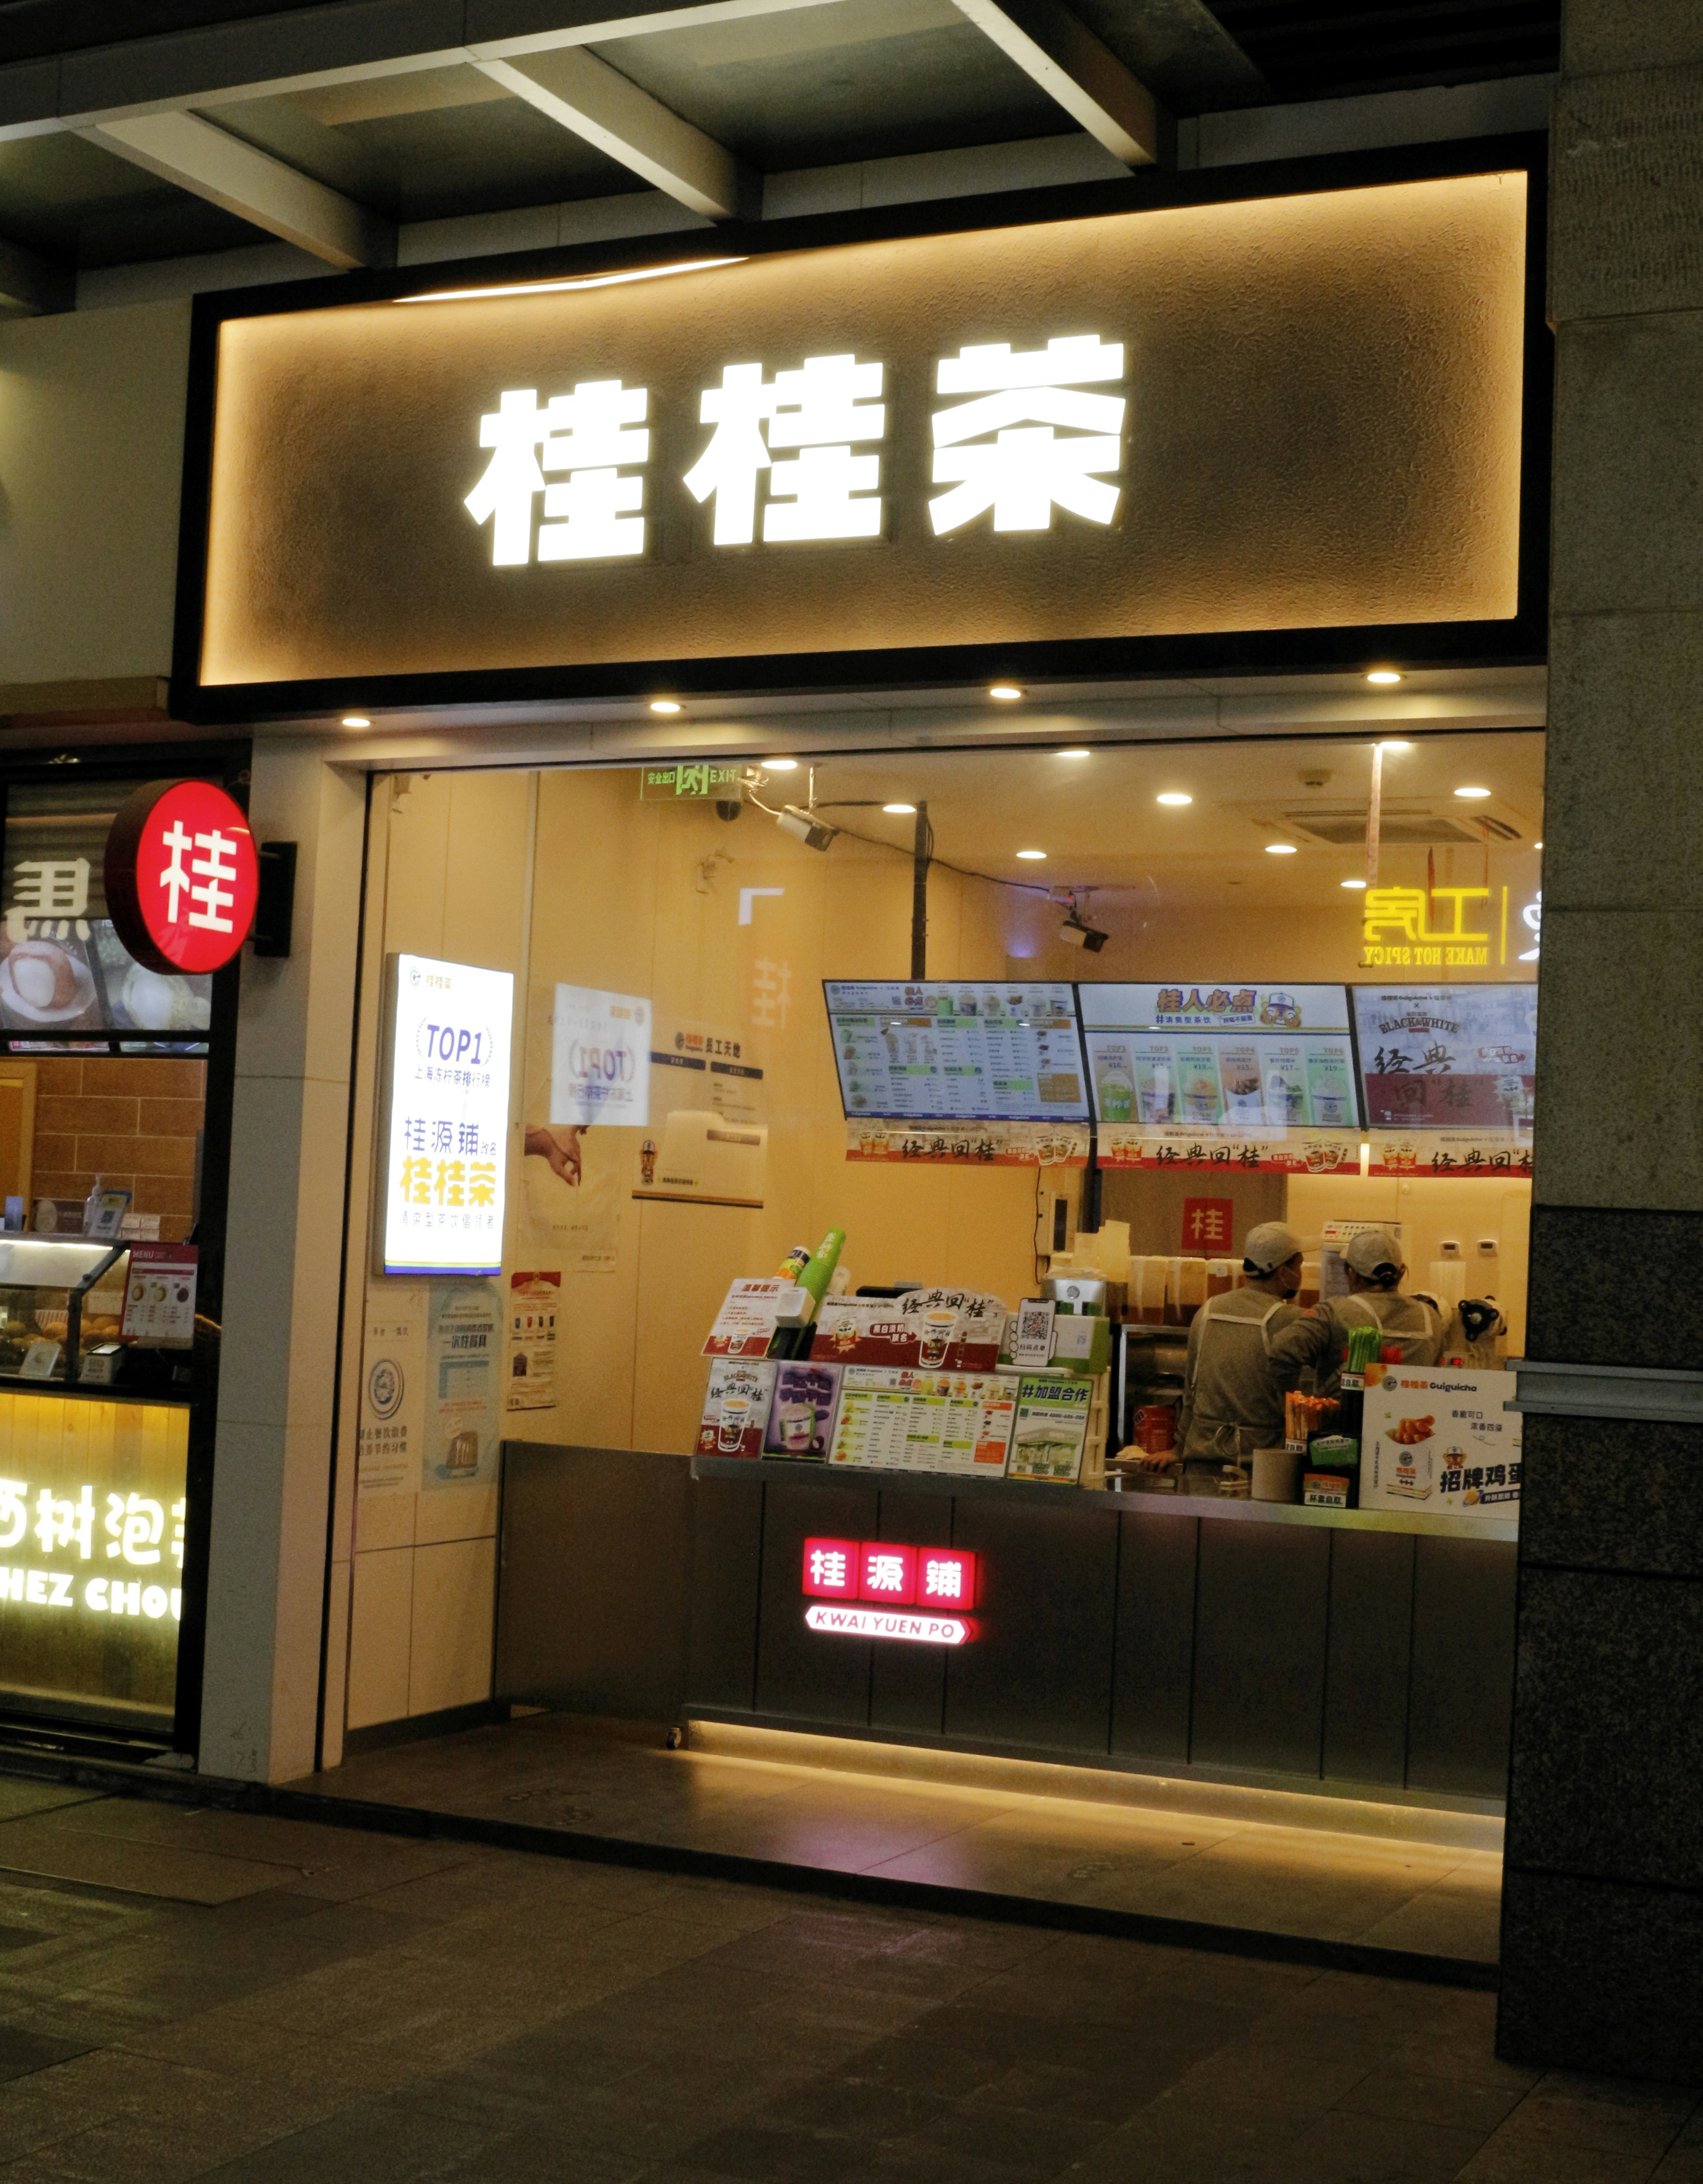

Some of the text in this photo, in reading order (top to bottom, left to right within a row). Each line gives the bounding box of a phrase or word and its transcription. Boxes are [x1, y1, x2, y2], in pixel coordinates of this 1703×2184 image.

[464, 335, 1125, 566] 桂桂茶
[647, 772, 675, 785] 安全出口
[710, 769, 737, 782] EXIT
[160, 820, 237, 933] 桂
[1157, 989, 1257, 1012] 桂人必点
[427, 1024, 481, 1064] TOP1
[400, 1155, 496, 1207] 桂桂茶
[1190, 1209, 1224, 1241] 桂
[132, 1250, 154, 1259] MENU
[1430, 1382, 1477, 1392] Guiguicha
[816, 1612, 954, 1638] KWAI YUEN PO
